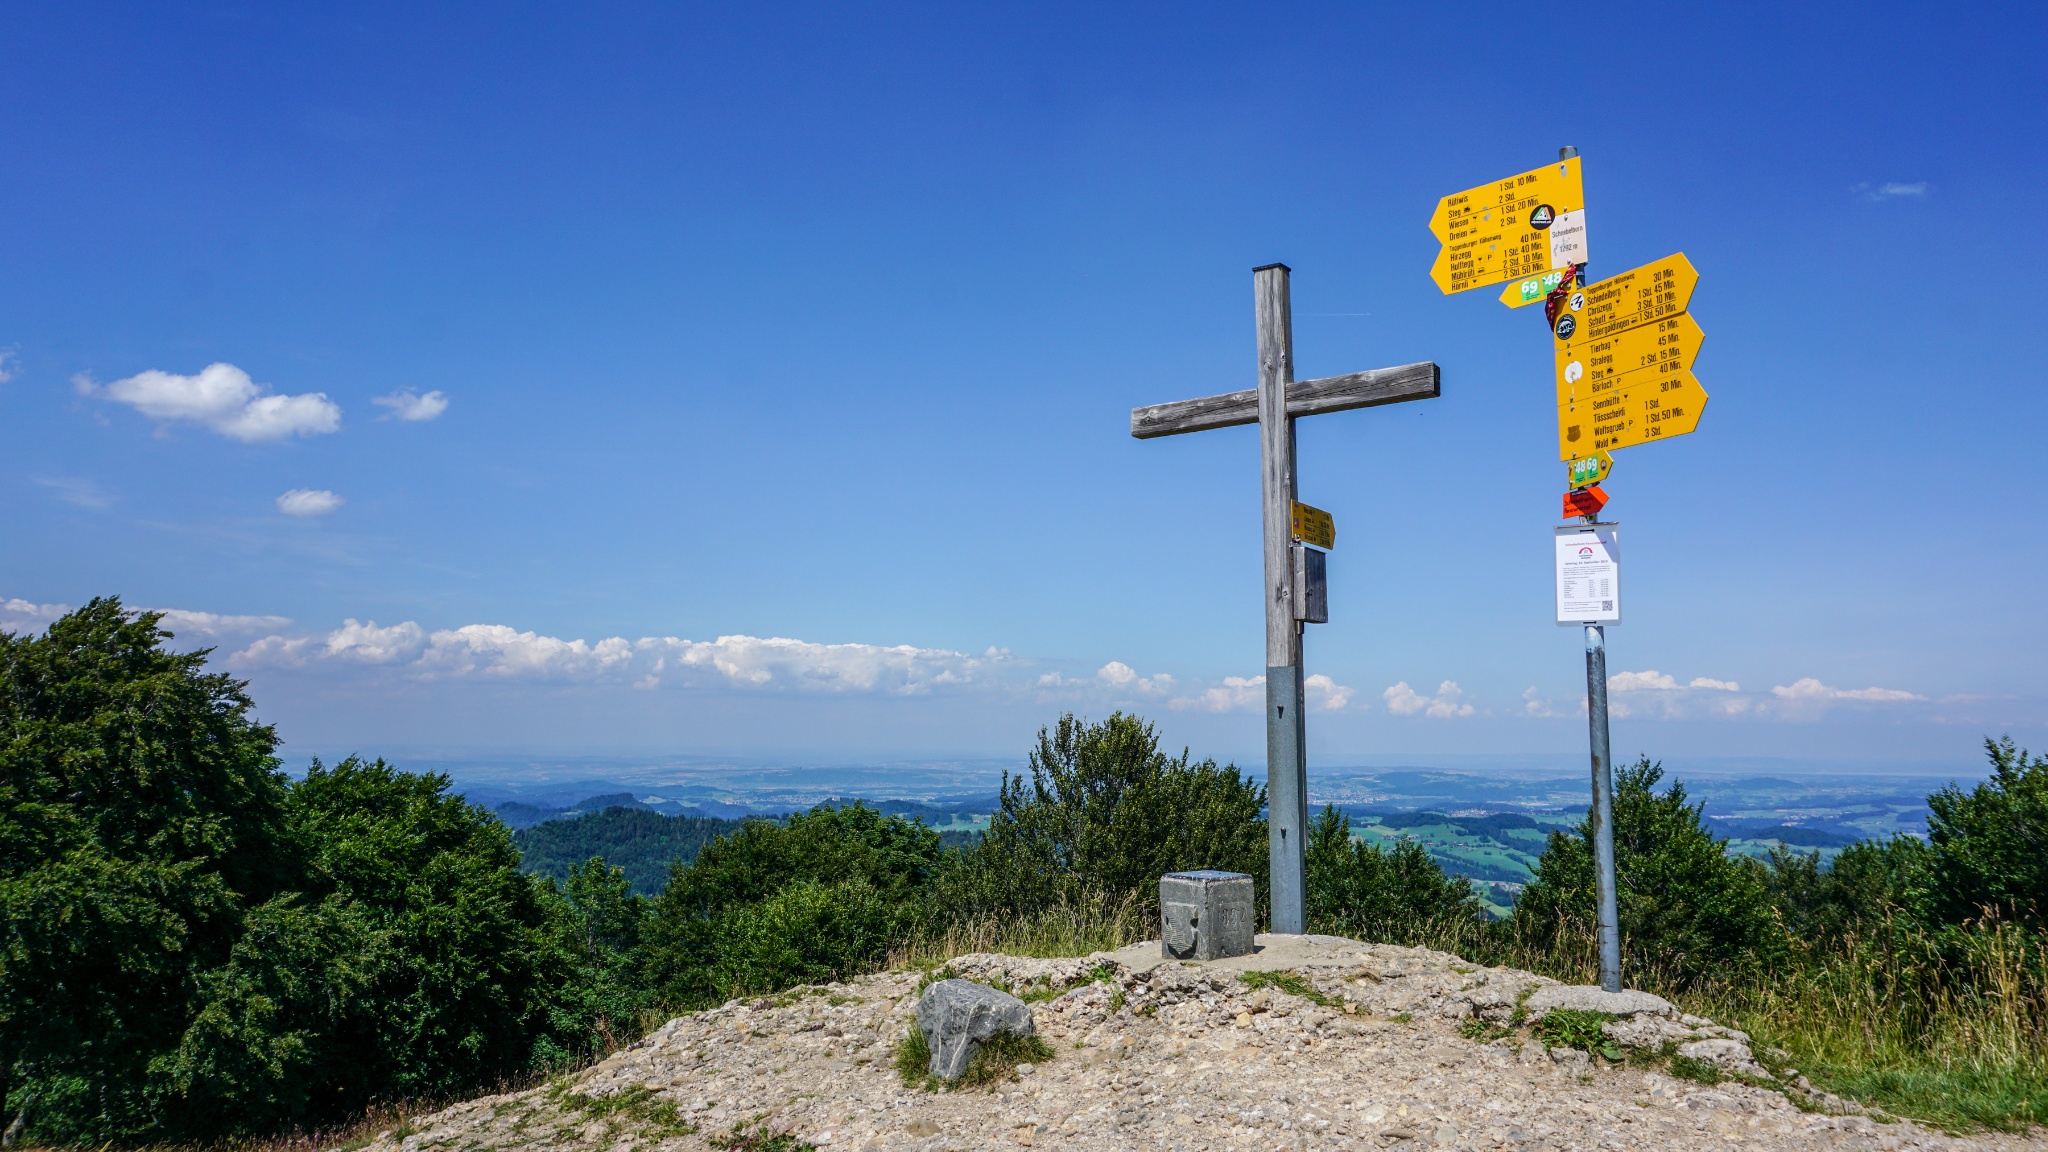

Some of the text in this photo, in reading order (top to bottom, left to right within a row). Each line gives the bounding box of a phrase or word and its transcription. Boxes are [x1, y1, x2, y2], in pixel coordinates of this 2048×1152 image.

[1448, 196, 1468, 207] Rütiwis
[1518, 178, 1524, 186] 10
[1526, 175, 1536, 184] Min.
[1448, 209, 1461, 218] Steg
[1499, 196, 1502, 204] 2
[1449, 219, 1468, 230] Wiesen
[1518, 201, 1526, 210] 20
[1528, 198, 1539, 207] Min.
[1450, 231, 1468, 240] Dreien
[1500, 218, 1504, 226] 2
[1450, 232, 1542, 261] Hirzegg 40 Min.
[1521, 244, 1530, 254] 40
[1530, 242, 1542, 250] Min.
[1504, 260, 1507, 268] 2
[1524, 254, 1530, 263] 10
[1532, 252, 1544, 261] Min.
[1504, 270, 1508, 278] 2
[1522, 264, 1530, 274] 50
[1532, 262, 1544, 272] Min.
[1521, 272, 1562, 294] 69 48
[1588, 269, 1675, 306] Schindelberg 30 Min.
[1588, 302, 1612, 316] Chrüzegg
[1654, 283, 1662, 292] 45
[1664, 280, 1676, 290] Min.
[1638, 302, 1642, 310] 3
[1656, 294, 1662, 304] 10
[1665, 291, 1676, 302] Min.
[1656, 306, 1664, 316] 50
[1666, 304, 1677, 313] Min.
[1590, 320, 1679, 354] Tierhag 15 Min.
[1658, 336, 1666, 346] 45
[1668, 334, 1680, 344] Min.
[1592, 370, 1604, 380] Steg
[1641, 356, 1645, 366] 2
[1660, 350, 1668, 359] 15
[1669, 347, 1681, 357] Min.
[1660, 363, 1668, 373] 40
[1670, 361, 1682, 371] Min.
[1592, 380, 1682, 410] Sennhütte 30 Min.
[1650, 398, 1660, 409] Std.
[1662, 409, 1670, 420] 50
[1672, 407, 1684, 418] Min.
[1595, 426, 1662, 449] Wald 3 Std.
[1575, 460, 1586, 473] 48
[1587, 458, 1597, 471] 69
